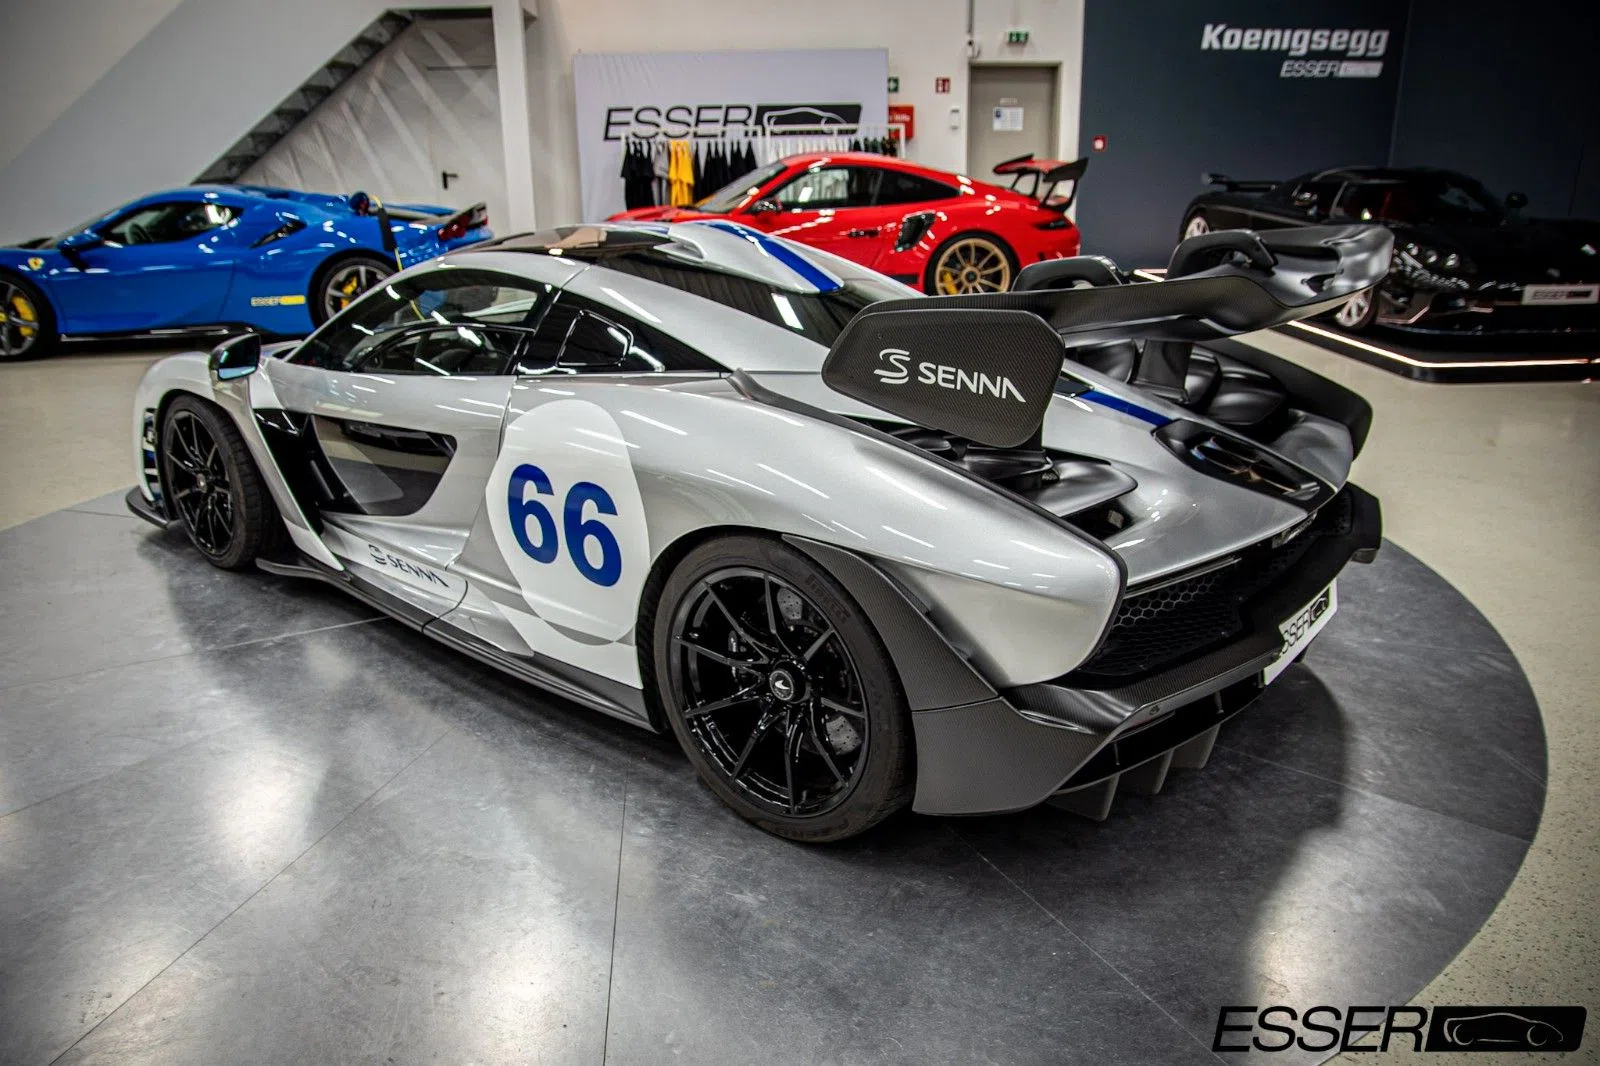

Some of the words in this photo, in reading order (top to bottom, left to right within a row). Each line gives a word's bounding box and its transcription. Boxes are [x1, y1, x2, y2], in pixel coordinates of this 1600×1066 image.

[1201, 23, 1390, 57] Koenigsegg
[1280, 60, 1341, 78] ESSER
[603, 105, 752, 141] ESSER
[917, 361, 1027, 403] SENNA
[507, 463, 622, 587] 66
[1281, 609, 1310, 655] SSER
